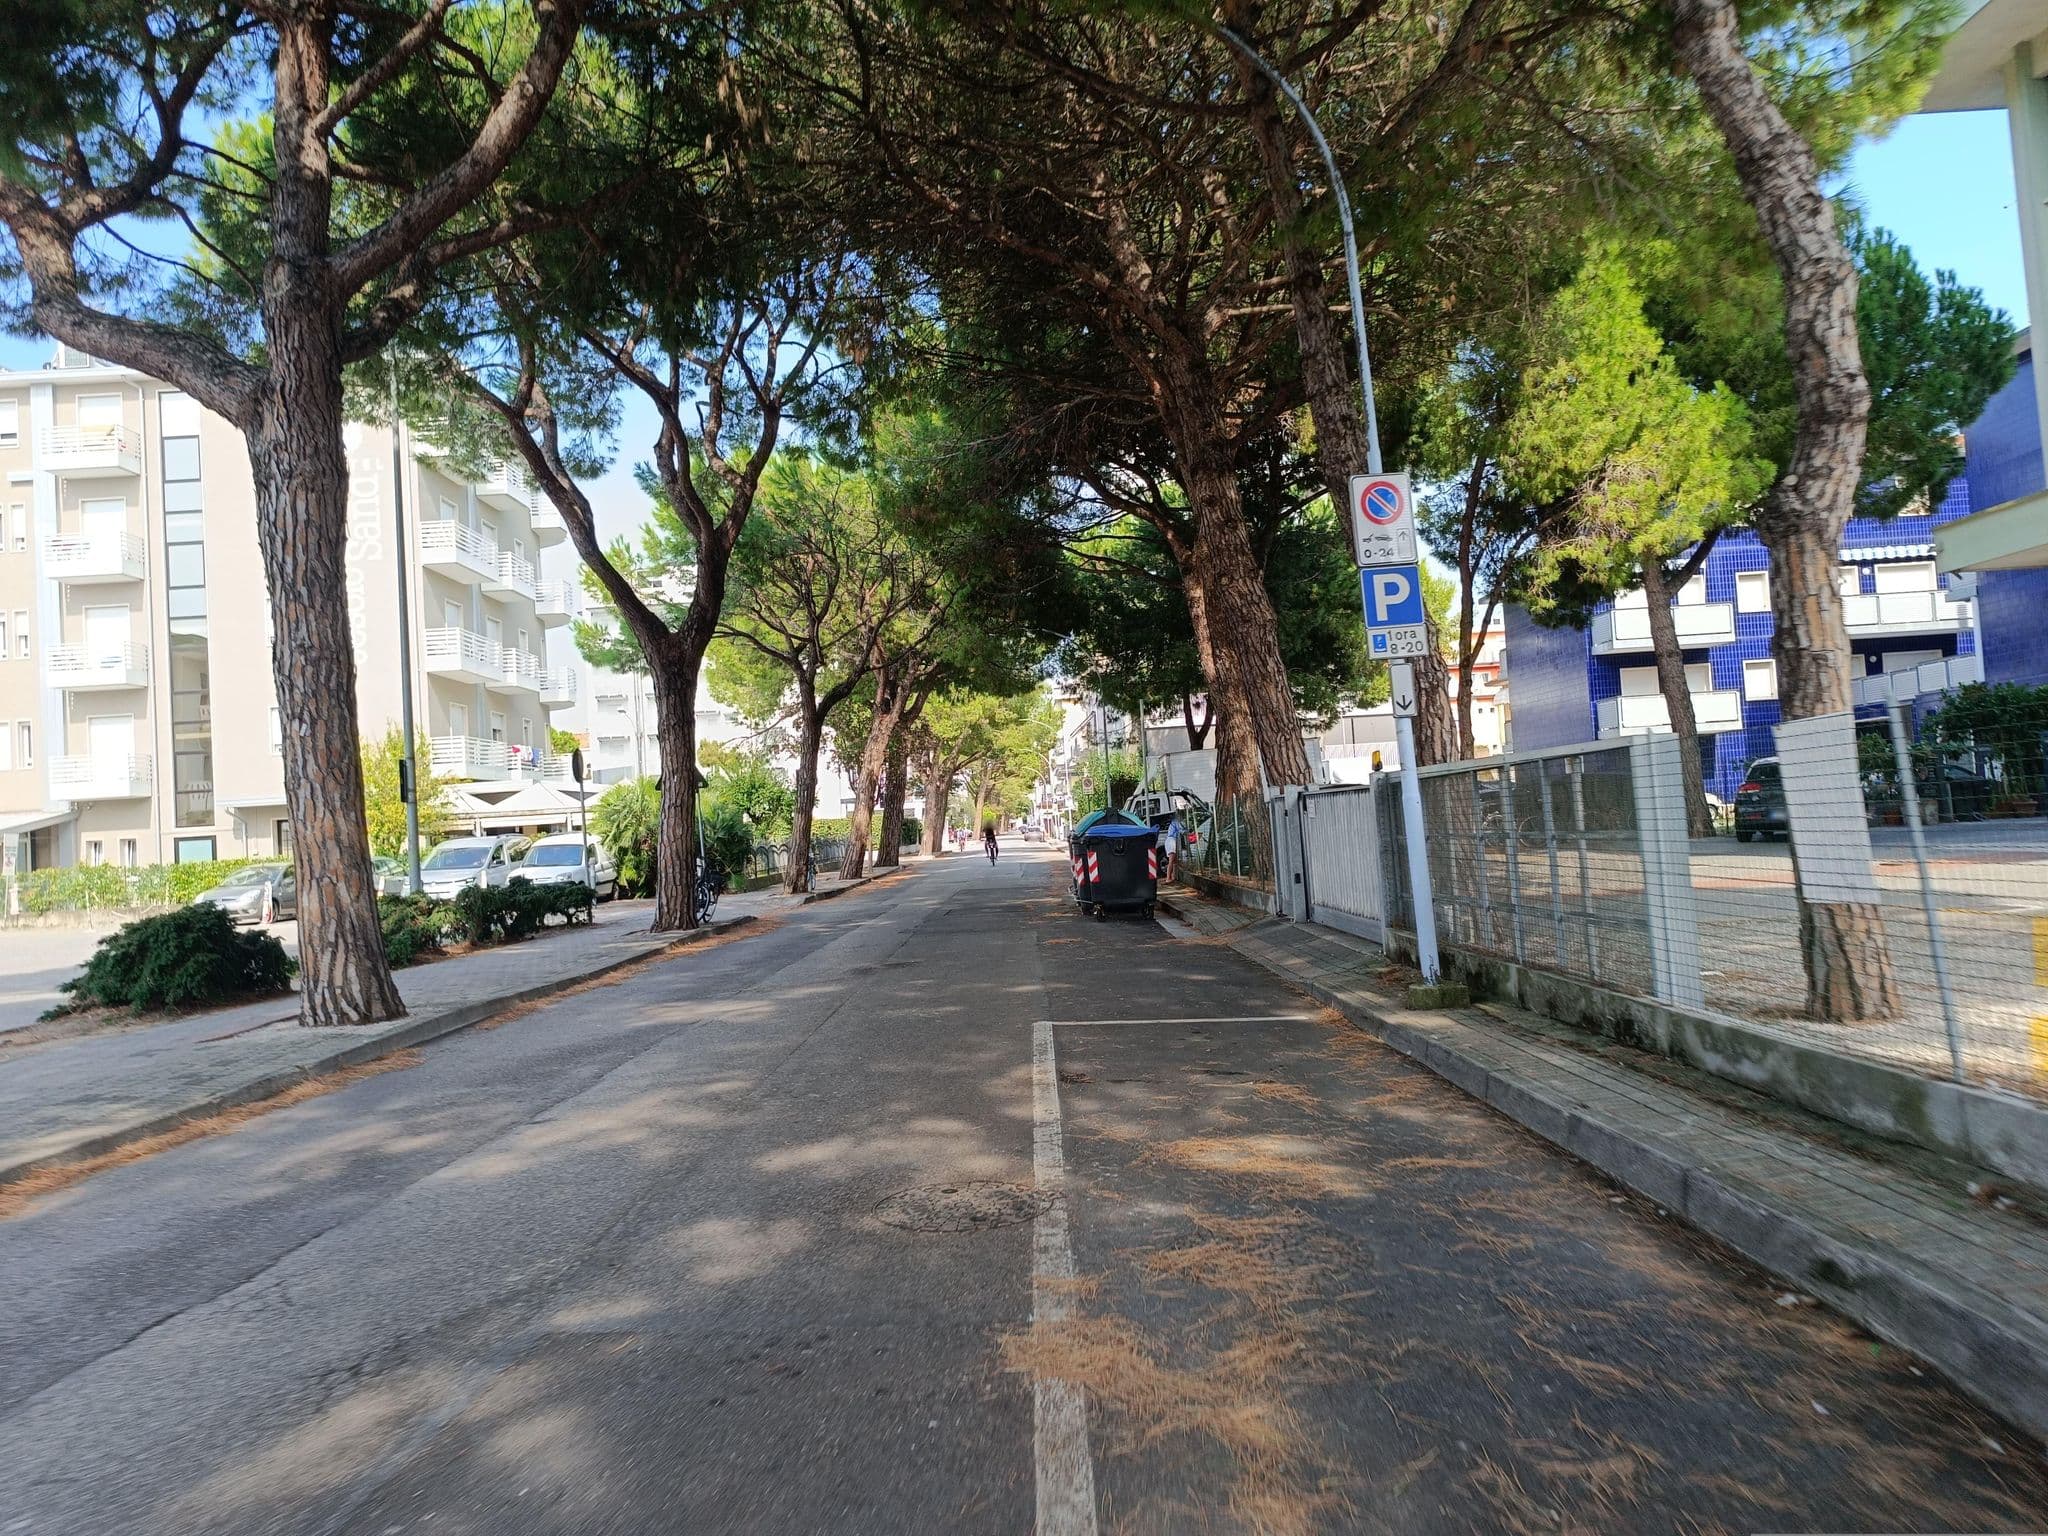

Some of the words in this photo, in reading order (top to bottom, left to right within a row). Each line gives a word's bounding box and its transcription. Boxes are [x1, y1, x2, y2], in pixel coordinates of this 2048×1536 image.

[1373, 573, 1411, 621] P
[1387, 630, 1393, 641] 1
[1395, 630, 1417, 641] ora
[1390, 641, 1424, 654] 8-20
